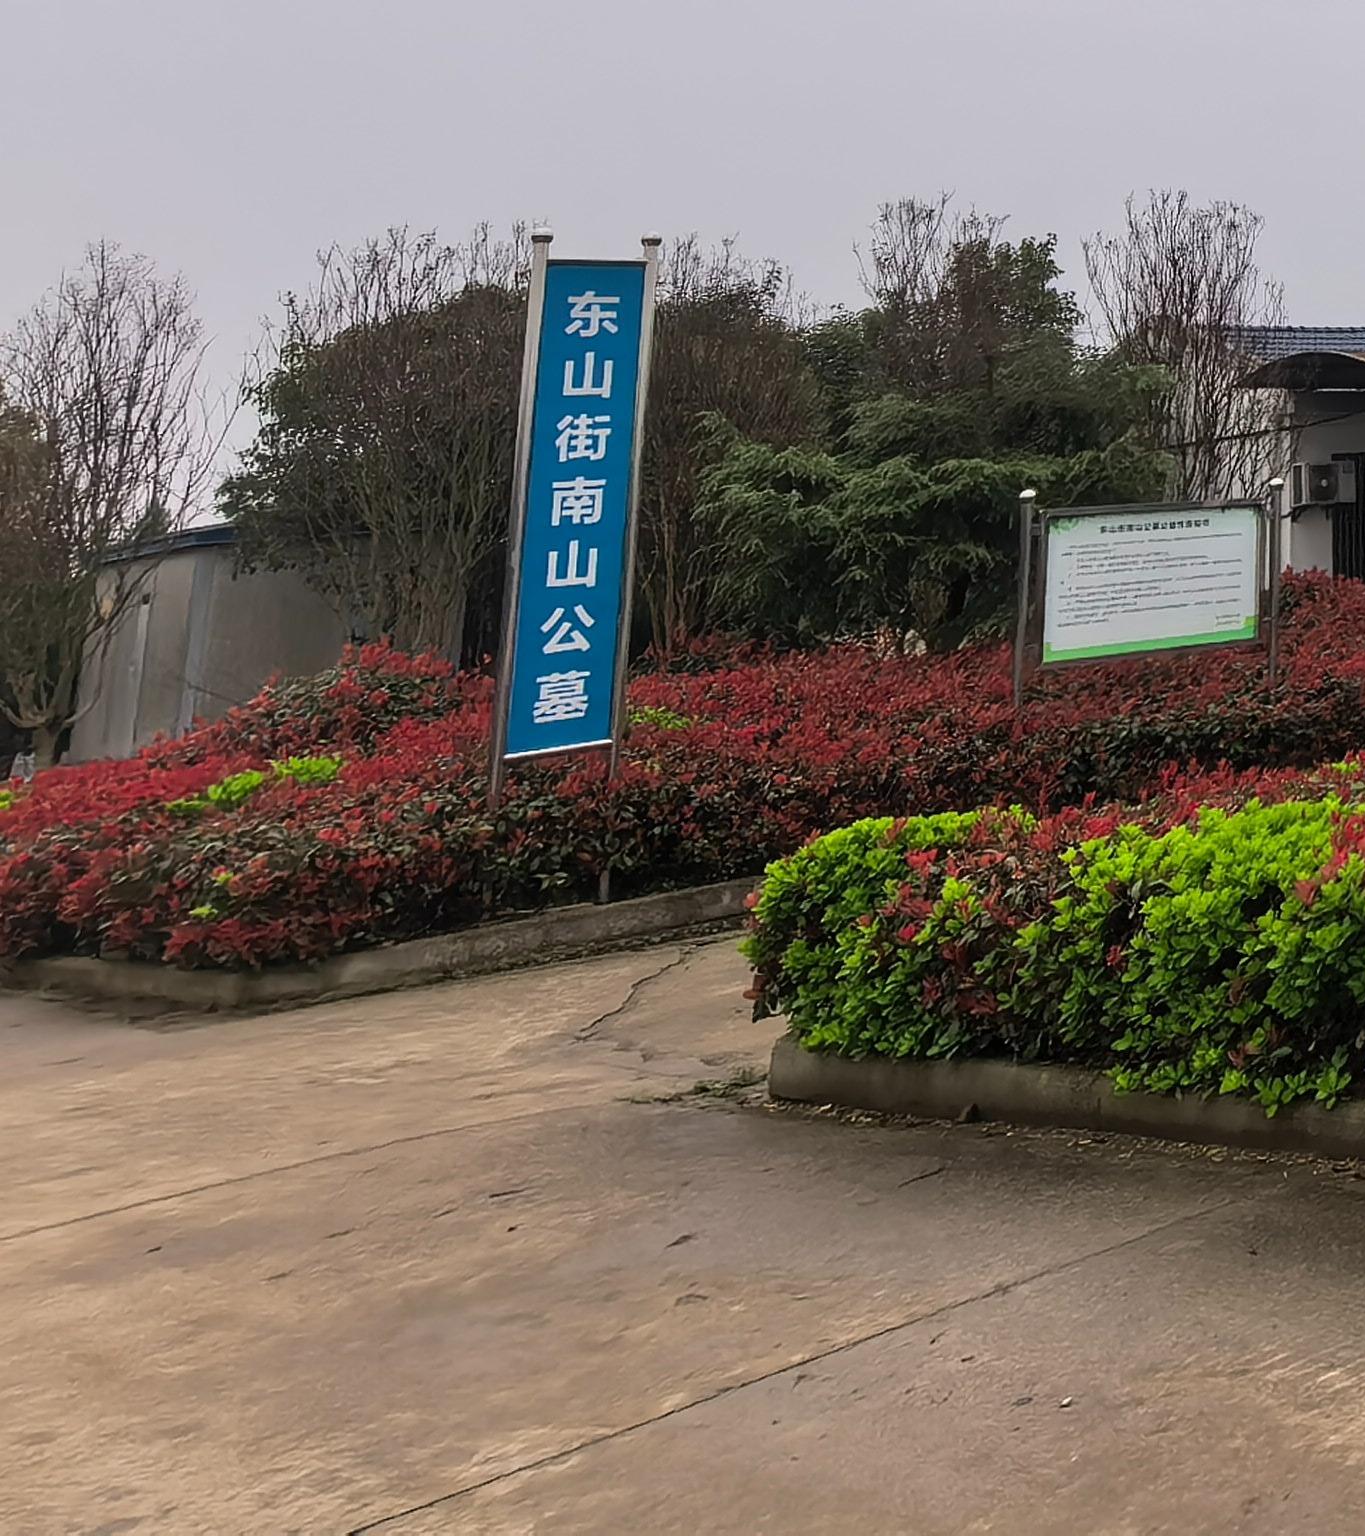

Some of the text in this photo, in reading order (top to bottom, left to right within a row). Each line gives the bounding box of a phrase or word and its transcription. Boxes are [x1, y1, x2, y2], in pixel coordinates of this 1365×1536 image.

[533, 291, 620, 724] 东山街南山公墓
